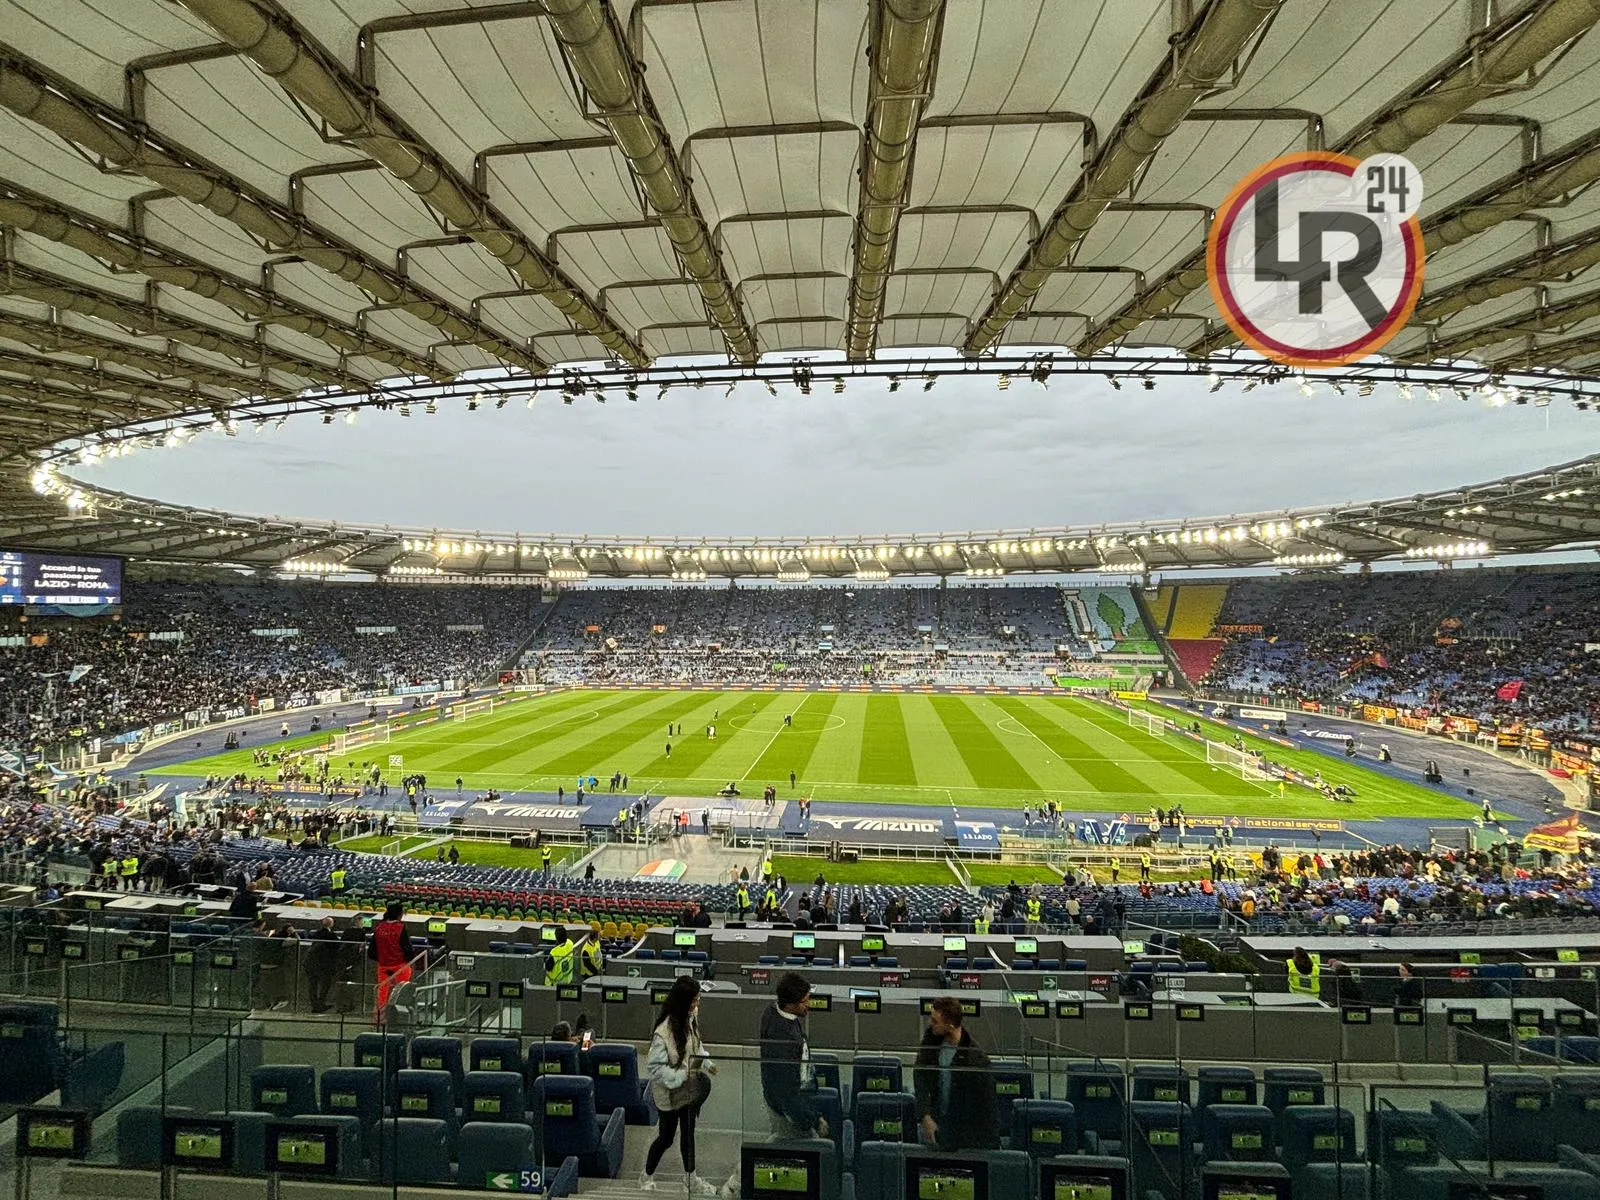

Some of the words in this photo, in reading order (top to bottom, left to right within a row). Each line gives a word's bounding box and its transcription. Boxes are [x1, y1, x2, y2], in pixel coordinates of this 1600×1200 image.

[40, 564, 76, 572] Accendi
[43, 572, 82, 580] passione
[34, 580, 70, 588] LAZIO
[77, 581, 109, 589] ROMA
[1247, 819, 1294, 828] national
[1295, 821, 1339, 829] services
[521, 1171, 541, 1187] 59
